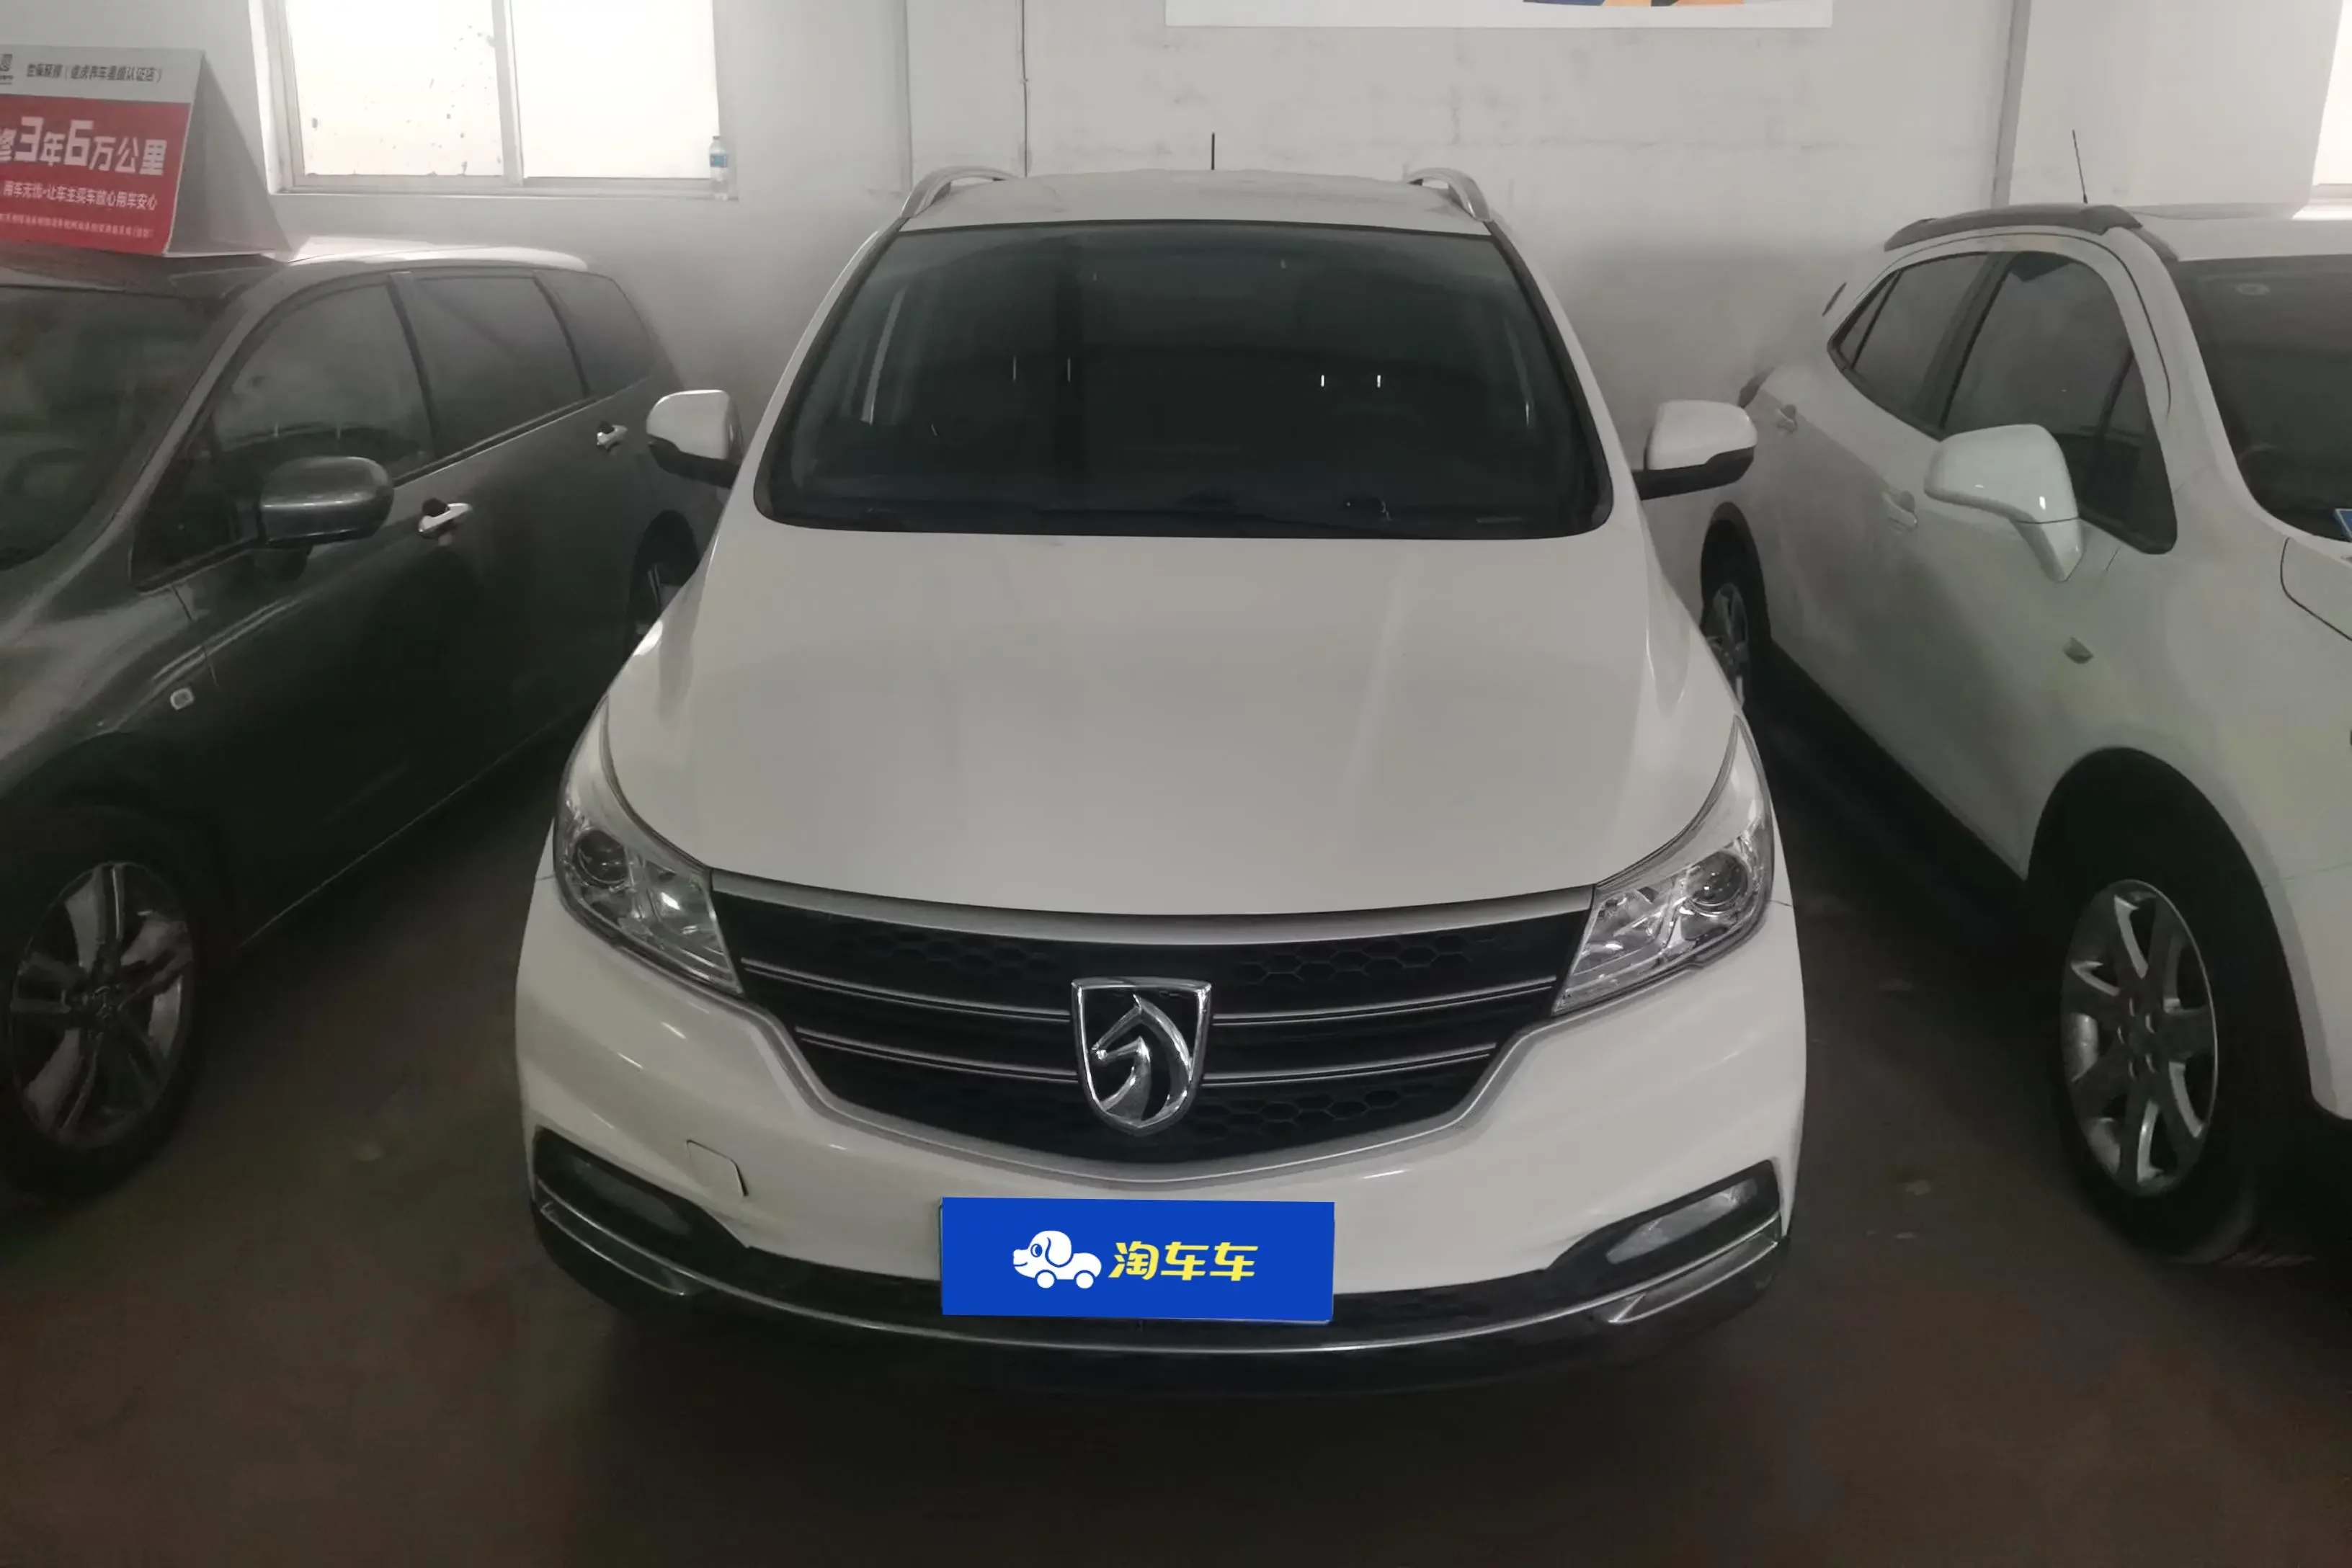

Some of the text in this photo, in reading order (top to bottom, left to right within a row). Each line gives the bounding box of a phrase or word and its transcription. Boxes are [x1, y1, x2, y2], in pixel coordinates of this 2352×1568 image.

[0, 116, 167, 176] 修3年6万公里
